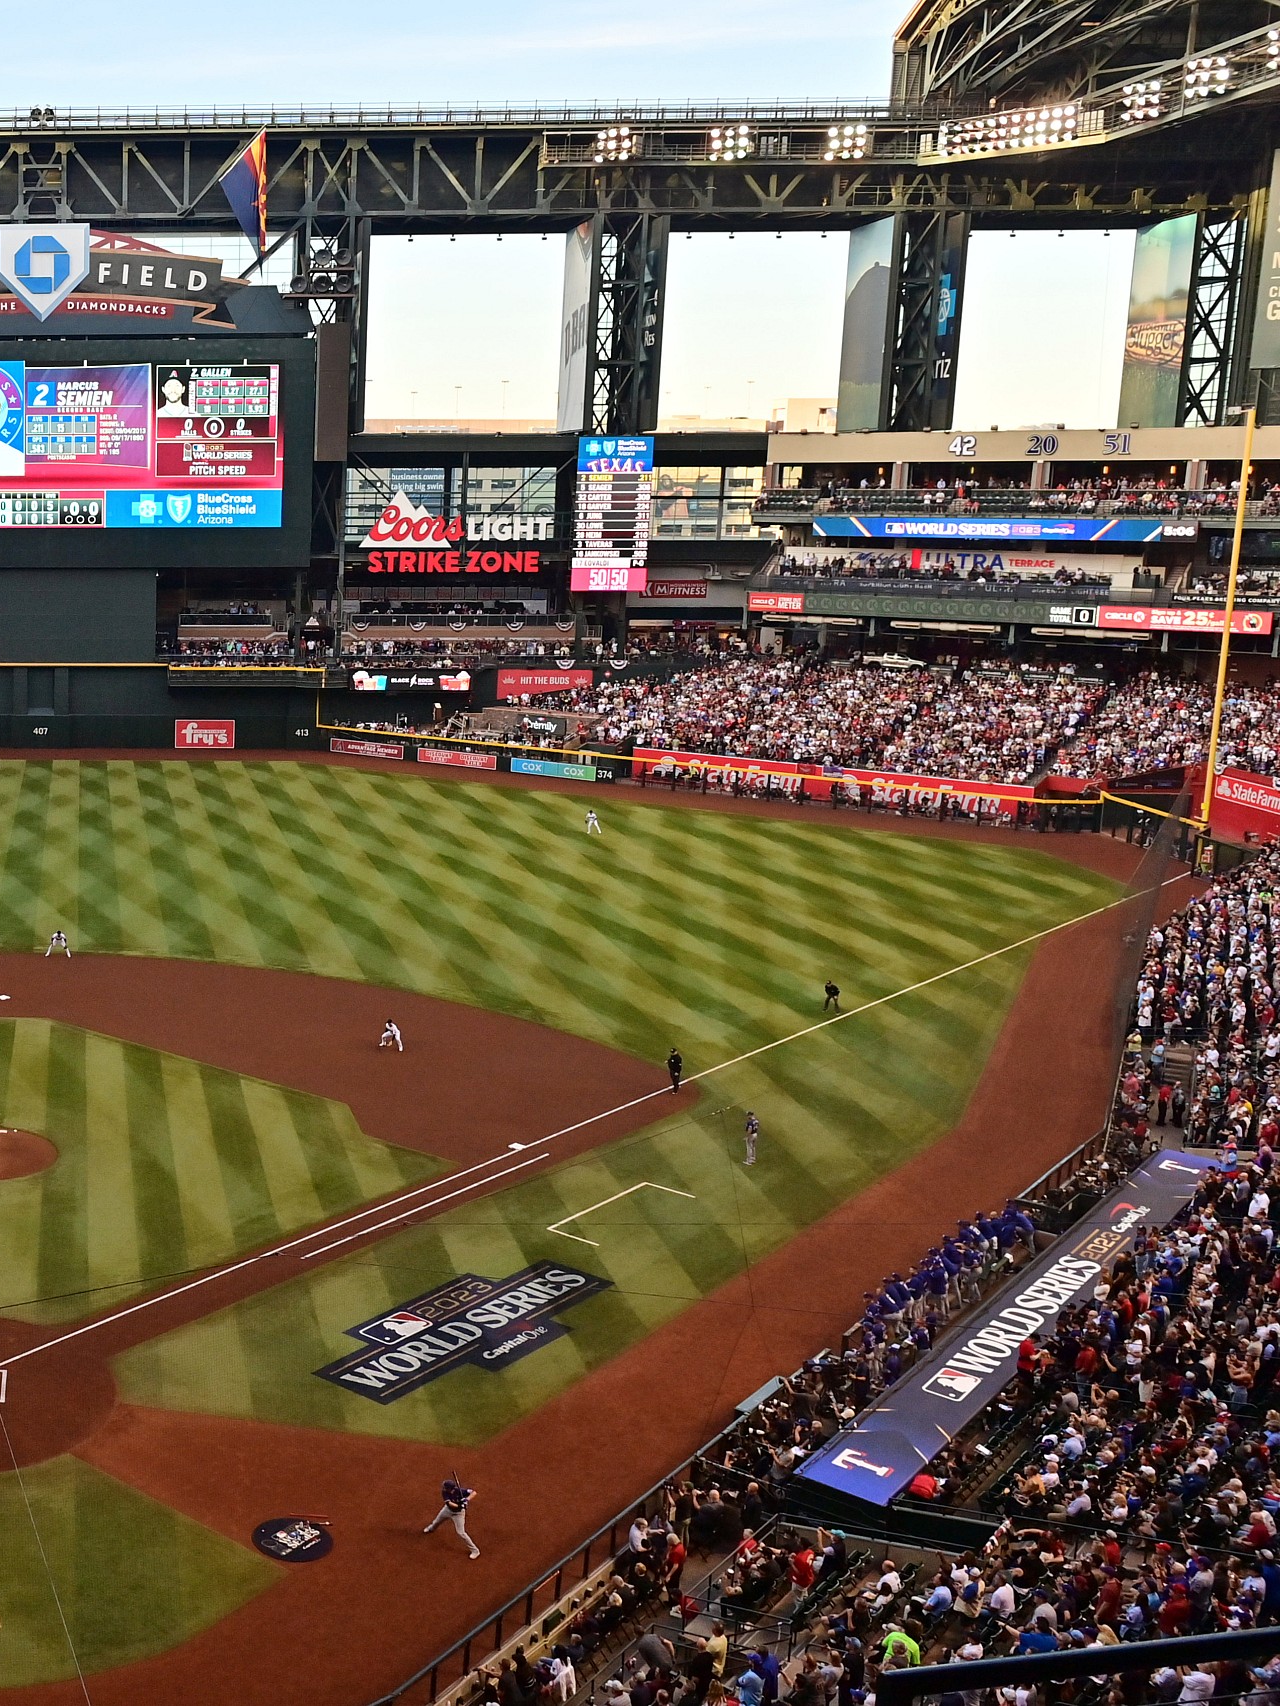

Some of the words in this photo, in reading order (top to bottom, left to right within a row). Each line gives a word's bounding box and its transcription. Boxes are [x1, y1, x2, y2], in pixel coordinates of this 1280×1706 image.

[98, 262, 208, 291] FIELD
[67, 301, 168, 316] DIAMONDBACKS
[200, 368, 232, 378] GALLEN
[57, 382, 99, 391] MARCUS
[33, 384, 50, 406] 2
[56, 391, 114, 406] SEMIEN
[948, 435, 976, 456] 42
[1025, 434, 1058, 455] 20
[1103, 433, 1130, 455] 51
[189, 465, 216, 475] PITCH
[218, 465, 246, 475] SPEED
[587, 458, 644, 472] TEXAS
[391, 472, 422, 480] business
[391, 482, 414, 491] taking
[415, 482, 428, 491] big
[429, 483, 445, 491] swin
[197, 493, 253, 503] BlueCross
[197, 504, 256, 515] BlueShield
[197, 515, 234, 525] Arizona
[369, 504, 465, 542] Coors
[466, 515, 555, 542] LIGHT
[905, 522, 959, 535] WORLD
[959, 523, 1011, 537] SERIES
[1163, 525, 1195, 537] 5:06
[368, 551, 461, 573] STRIKE
[465, 551, 541, 573] ZONE
[1008, 558, 1055, 568] TERRACE
[669, 587, 707, 595] FITNESS
[777, 601, 802, 610] METER
[1050, 606, 1072, 615] GAME
[1049, 614, 1072, 623] TOTAL
[1079, 610, 1089, 622] 0
[1105, 613, 1132, 621] CIRCLE
[1150, 616, 1181, 625] SAVE
[520, 675, 532, 685] HIT
[534, 675, 548, 685] THE
[549, 676, 570, 686] BUDS
[32, 727, 49, 736] 407
[181, 722, 228, 746] fry's
[294, 729, 309, 737] 413
[347, 744, 376, 752] ADVANTAGE
[377, 747, 398, 755] MEMBER
[521, 762, 542, 772] COX
[563, 767, 585, 776] COX
[597, 769, 613, 780] 374
[416, 1281, 492, 1319] 2023
[947, 1304, 1045, 1374] WORLD
[1014, 1254, 1102, 1315] SERIES
[1080, 1231, 1121, 1260] 2023
[340, 1321, 483, 1389] WORLD
[469, 1269, 586, 1329] SERIES
